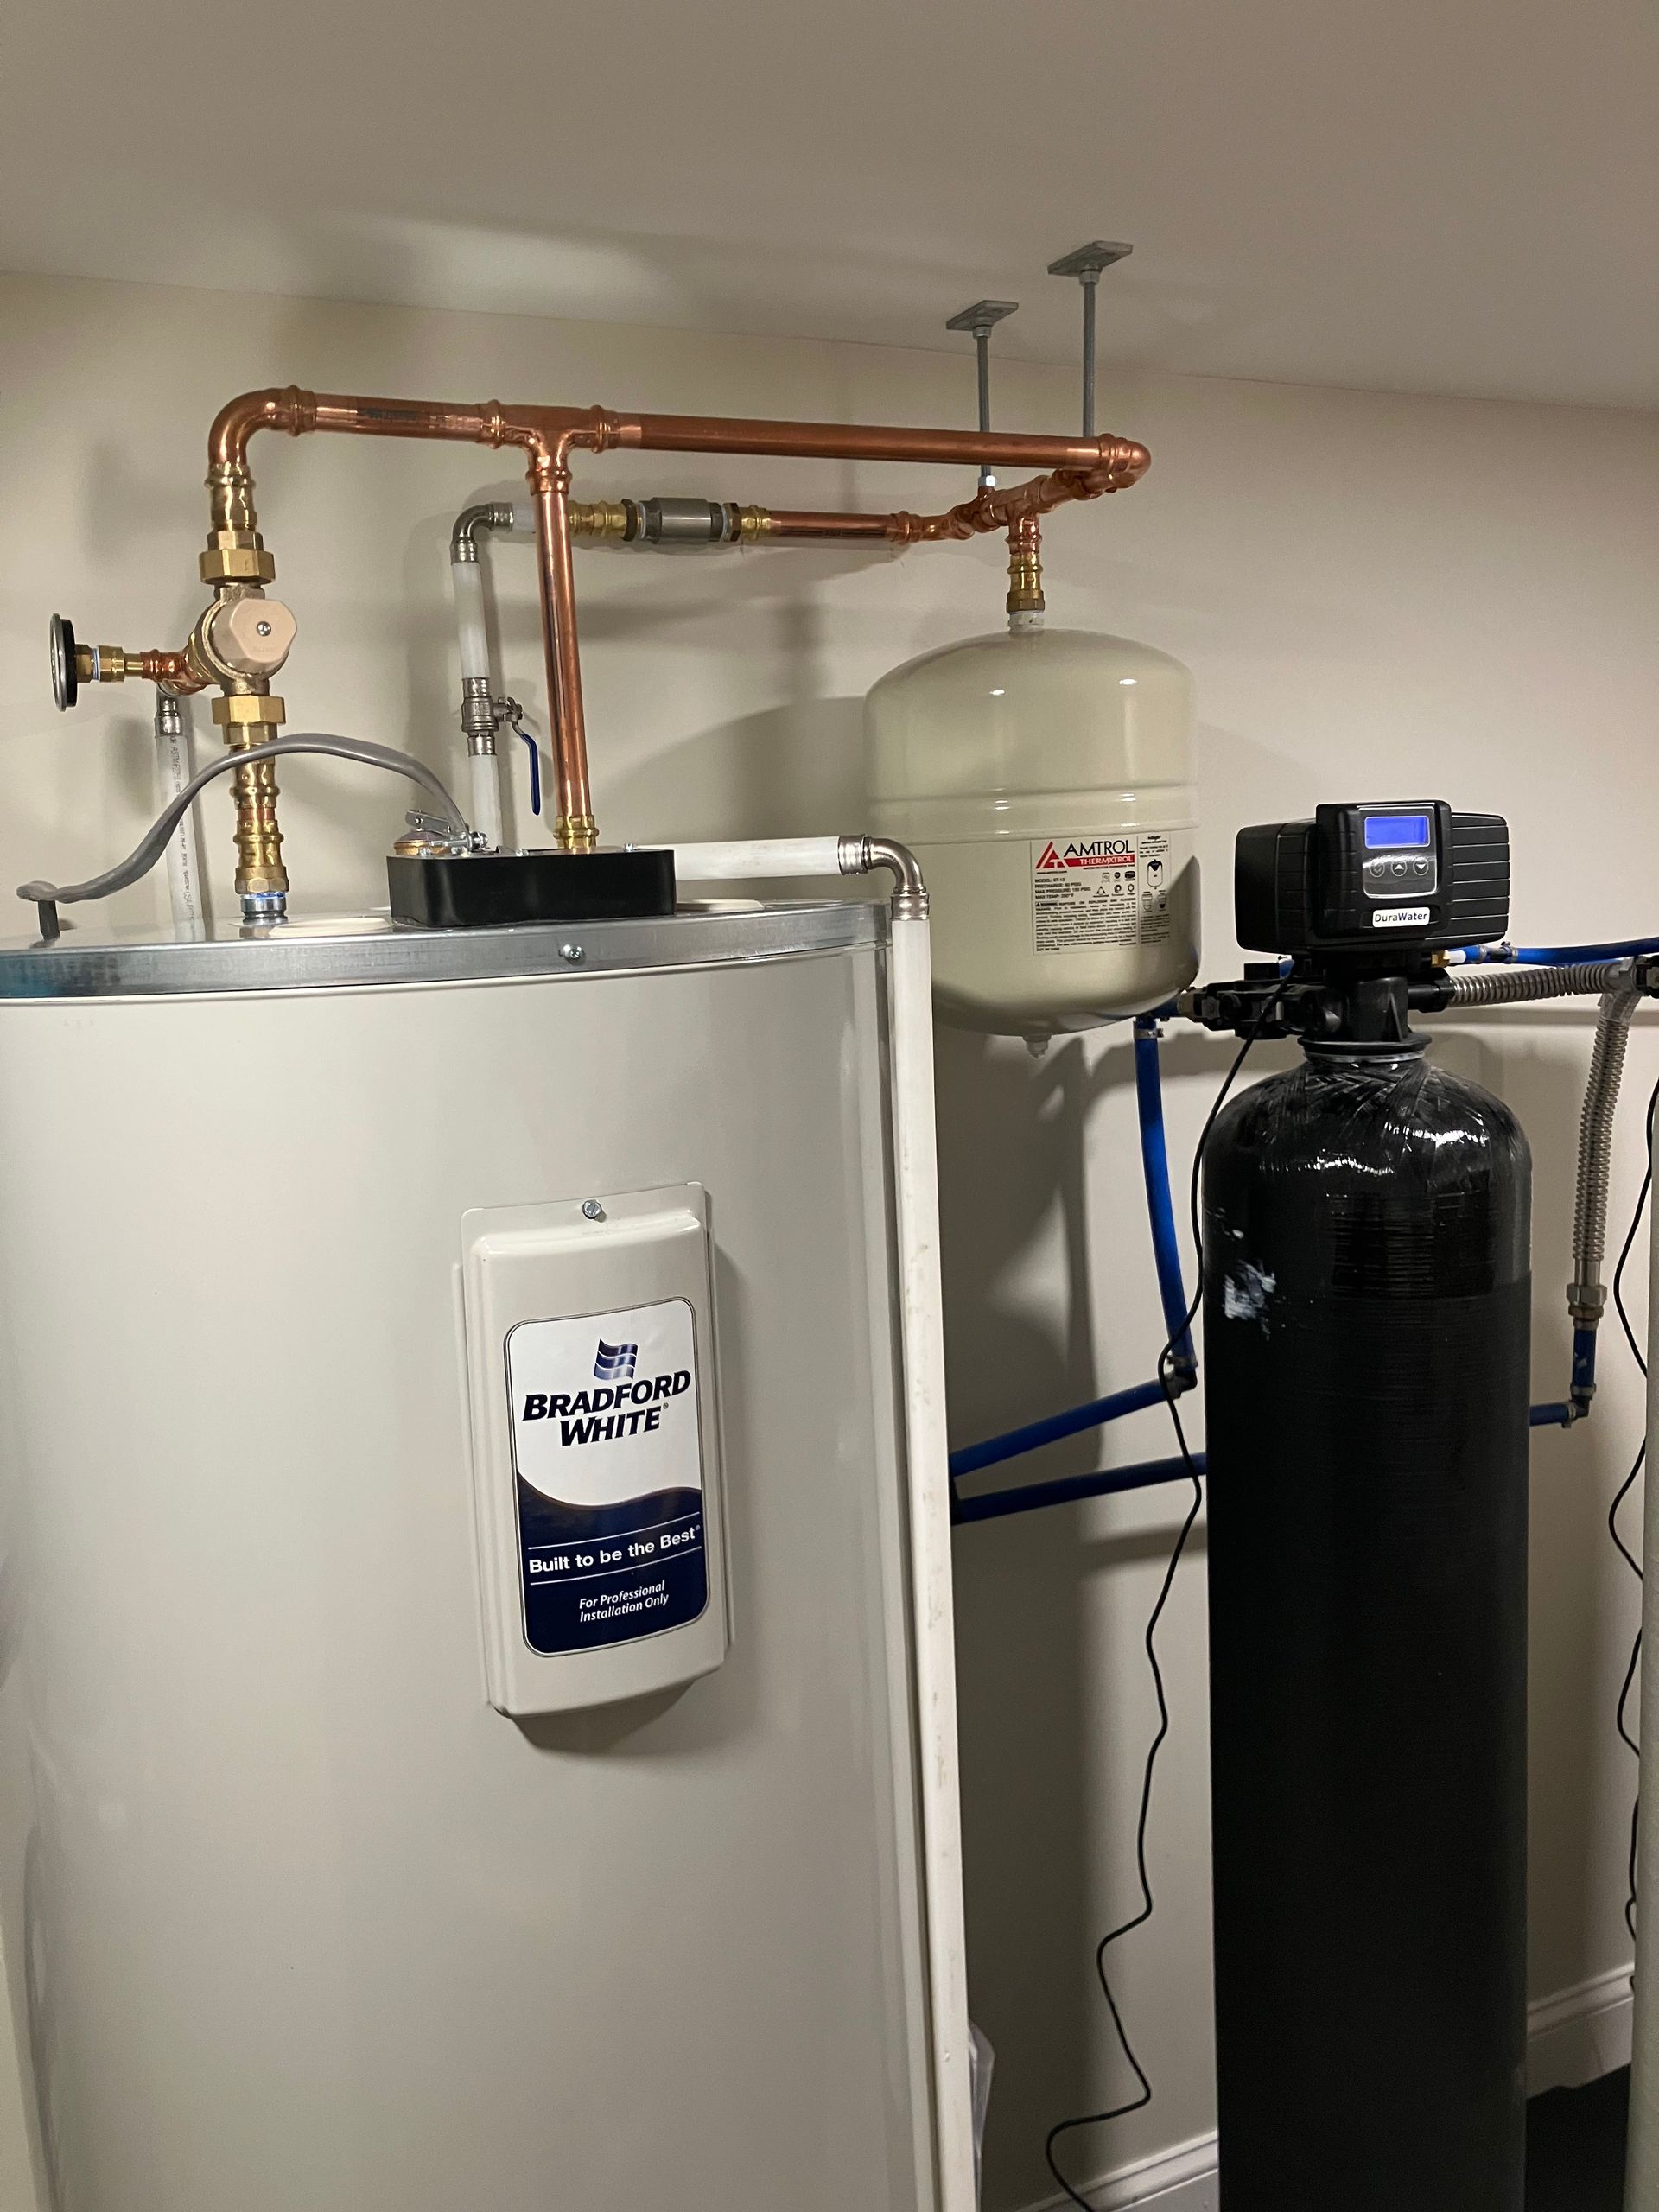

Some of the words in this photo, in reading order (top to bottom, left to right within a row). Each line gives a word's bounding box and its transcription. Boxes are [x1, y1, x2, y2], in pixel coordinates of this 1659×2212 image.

[1064, 840, 1135, 857] AMTROL
[1375, 912, 1427, 922] DuraWater
[522, 1370, 691, 1421] BRADFORD
[529, 1556, 570, 1573] Built
[575, 1554, 594, 1567] to
[599, 1549, 622, 1564] be
[627, 1542, 655, 1558] the
[578, 1598, 598, 1610] For
[600, 1579, 665, 1606] Professional
[579, 1600, 643, 1623] Installation
[645, 1593, 670, 1609] Only
